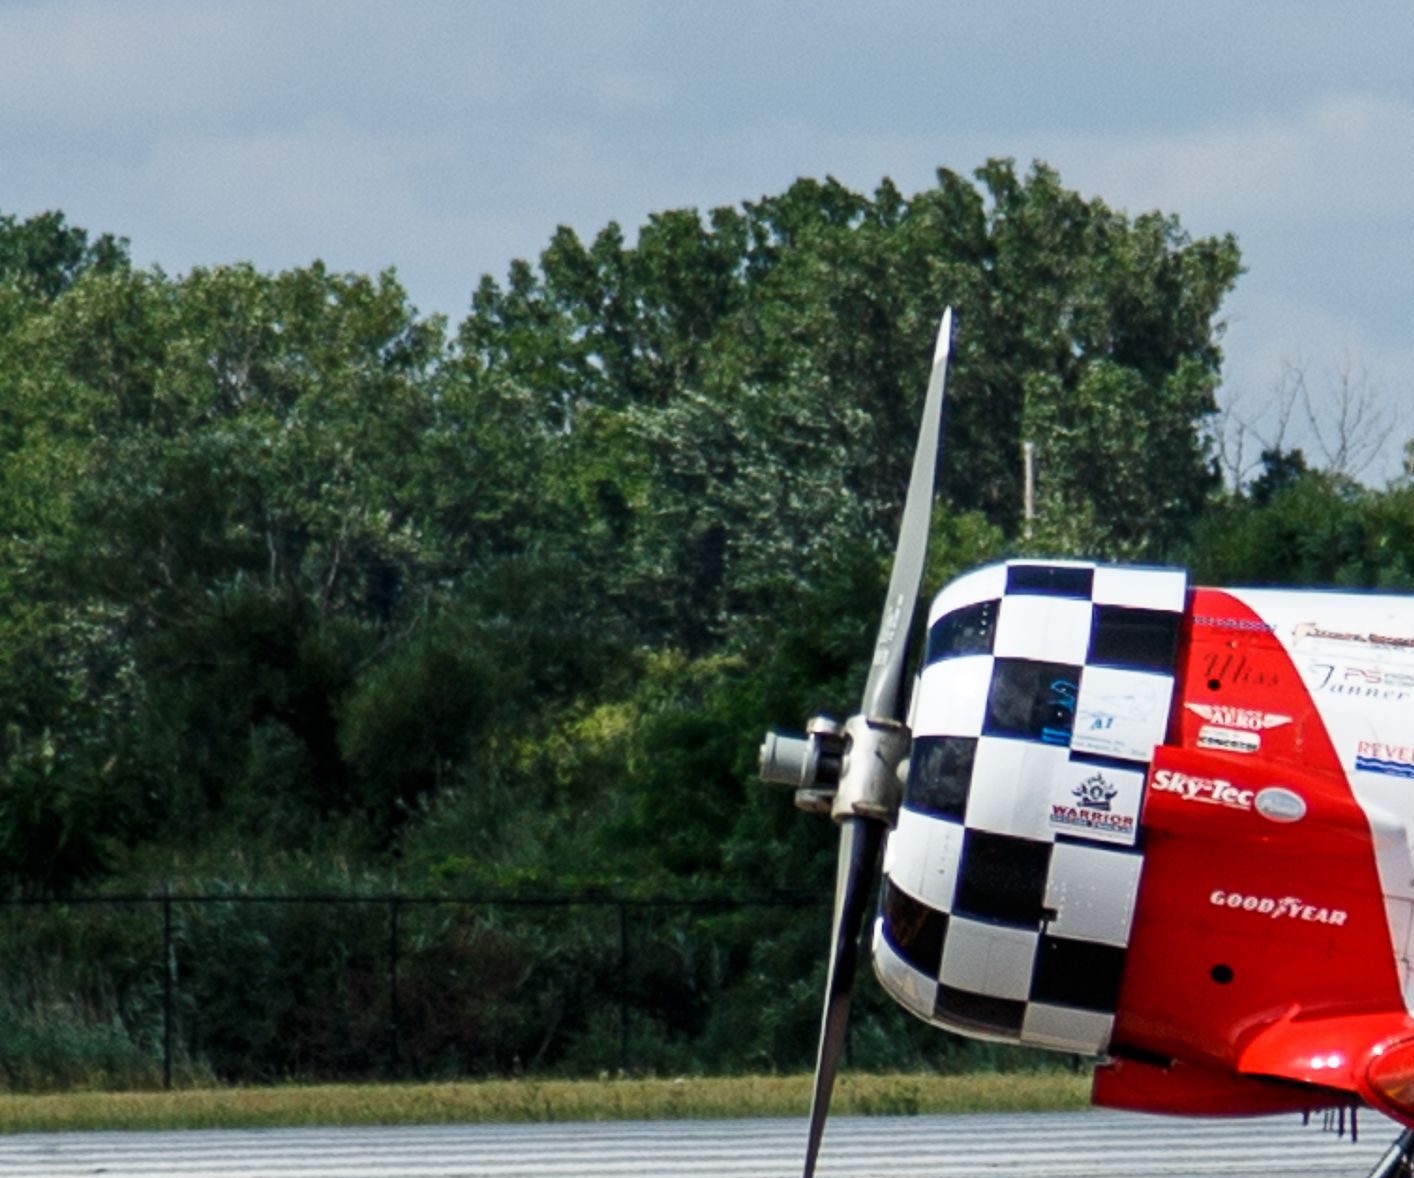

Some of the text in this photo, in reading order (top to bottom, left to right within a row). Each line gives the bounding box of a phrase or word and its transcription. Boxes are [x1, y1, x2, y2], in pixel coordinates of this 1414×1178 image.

[1310, 663, 1411, 699] Tanner
[1210, 711, 1261, 730] AERO
[1152, 769, 1255, 806] Sky-Tec
[1051, 804, 1134, 827] WARRIOR
[1209, 890, 1348, 926] GOODYEAR
